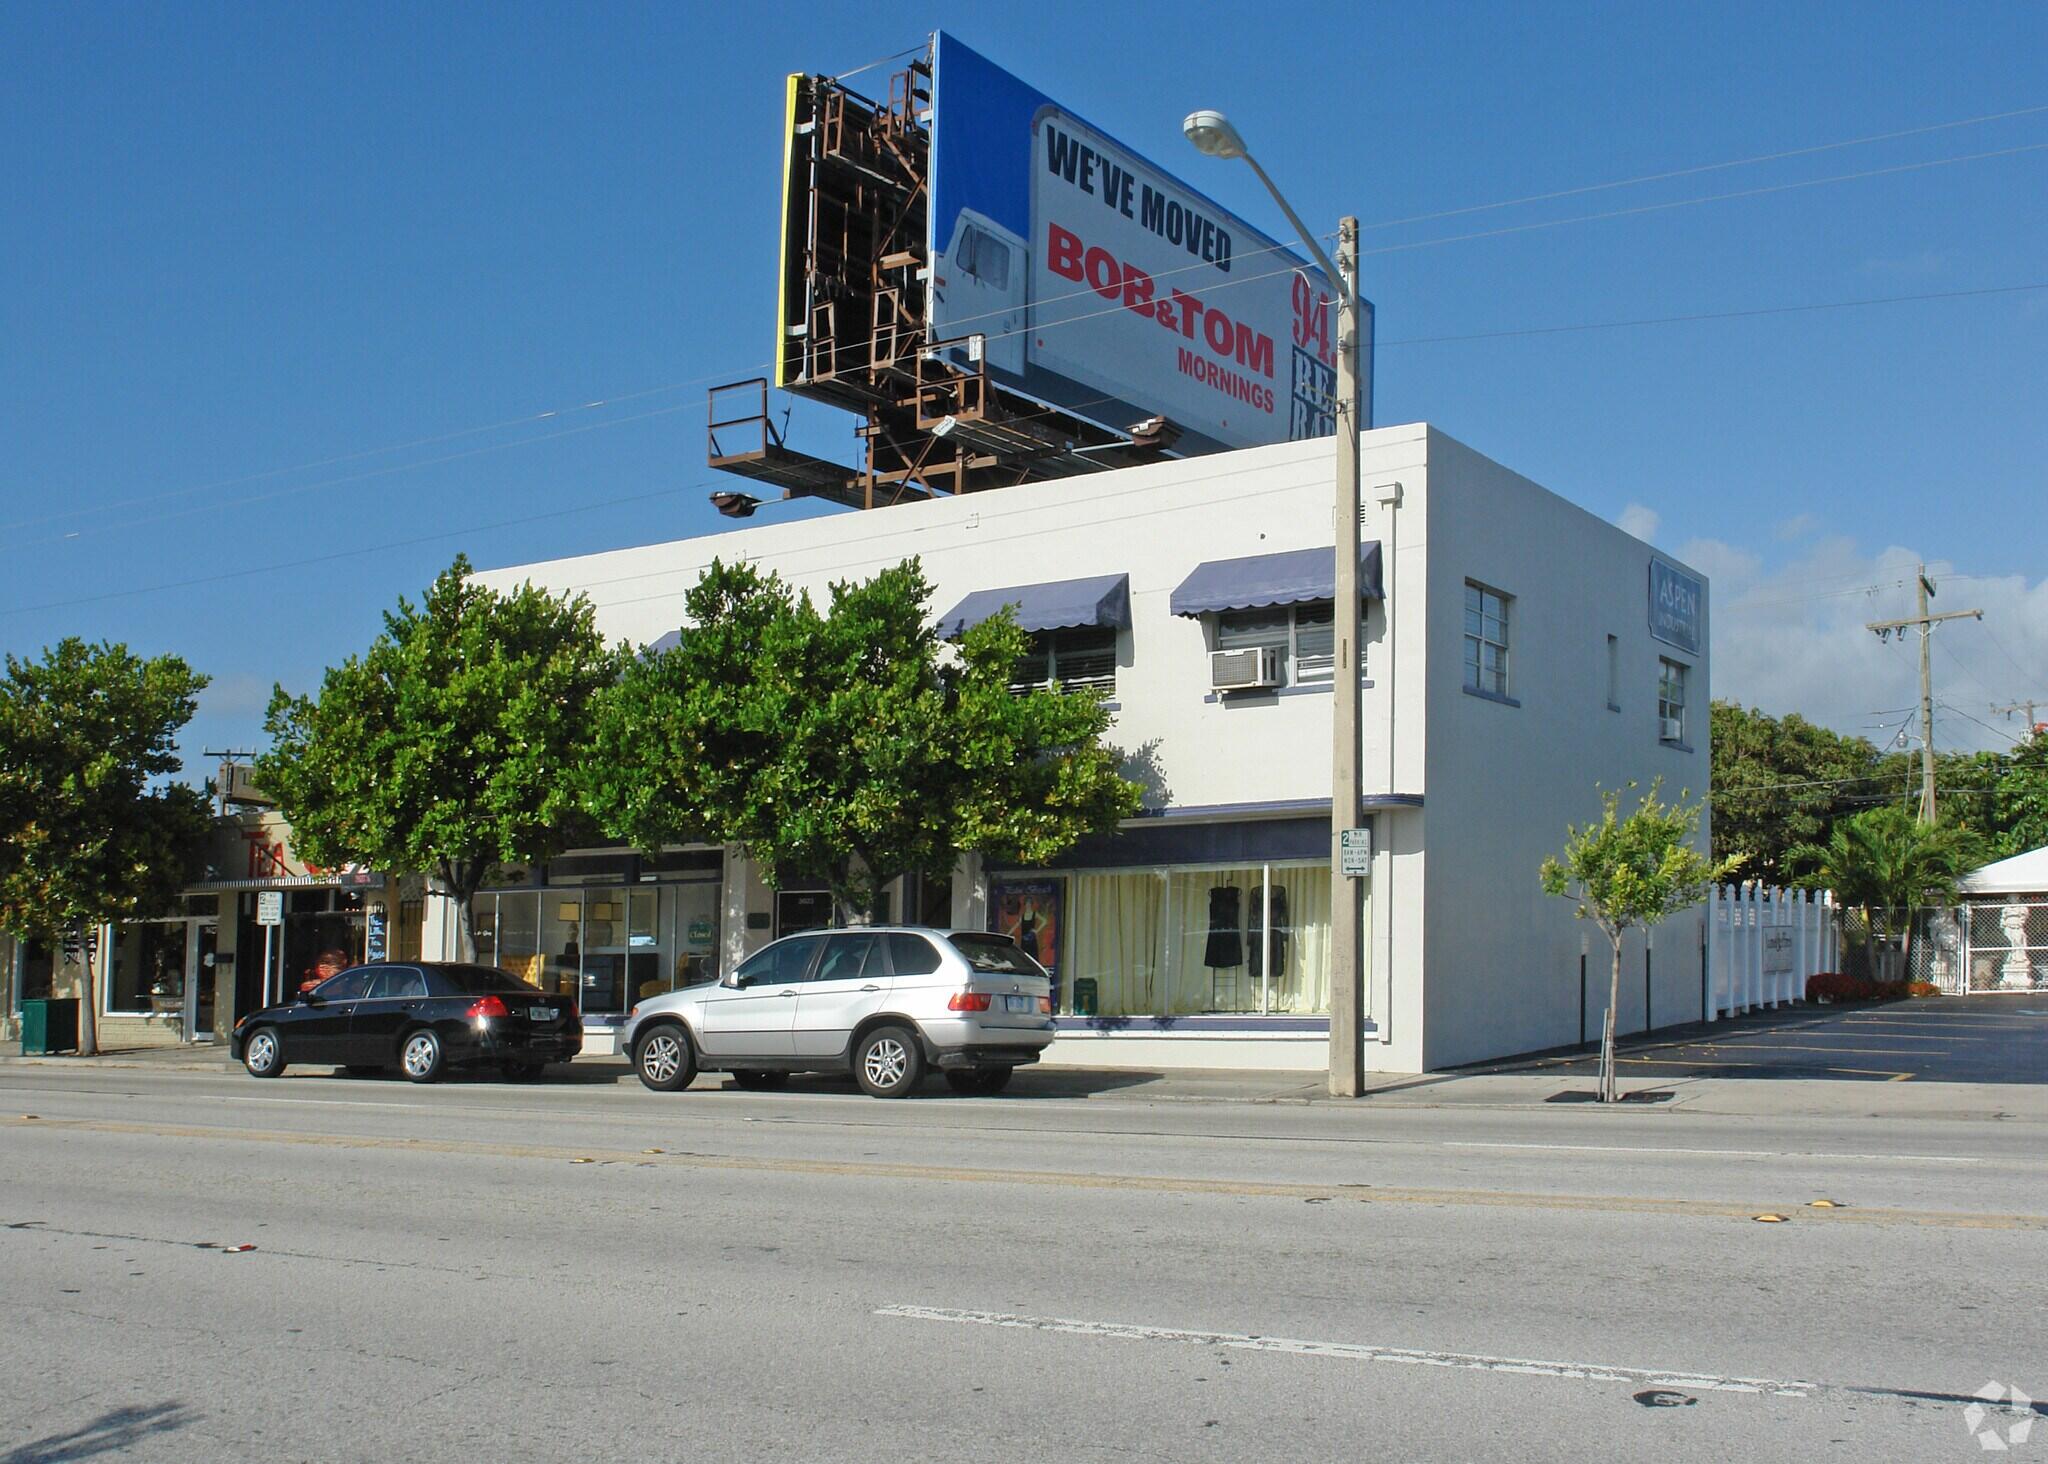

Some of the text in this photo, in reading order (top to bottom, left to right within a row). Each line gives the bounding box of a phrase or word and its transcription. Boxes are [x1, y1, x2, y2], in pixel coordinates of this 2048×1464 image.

[1047, 124, 1232, 273] WE'VE MOVED
[1178, 347, 1274, 414] MORNINGS
[1660, 579, 1696, 617] ASPEN
[242, 831, 286, 878] TEA
[1342, 832, 1349, 845] 2
